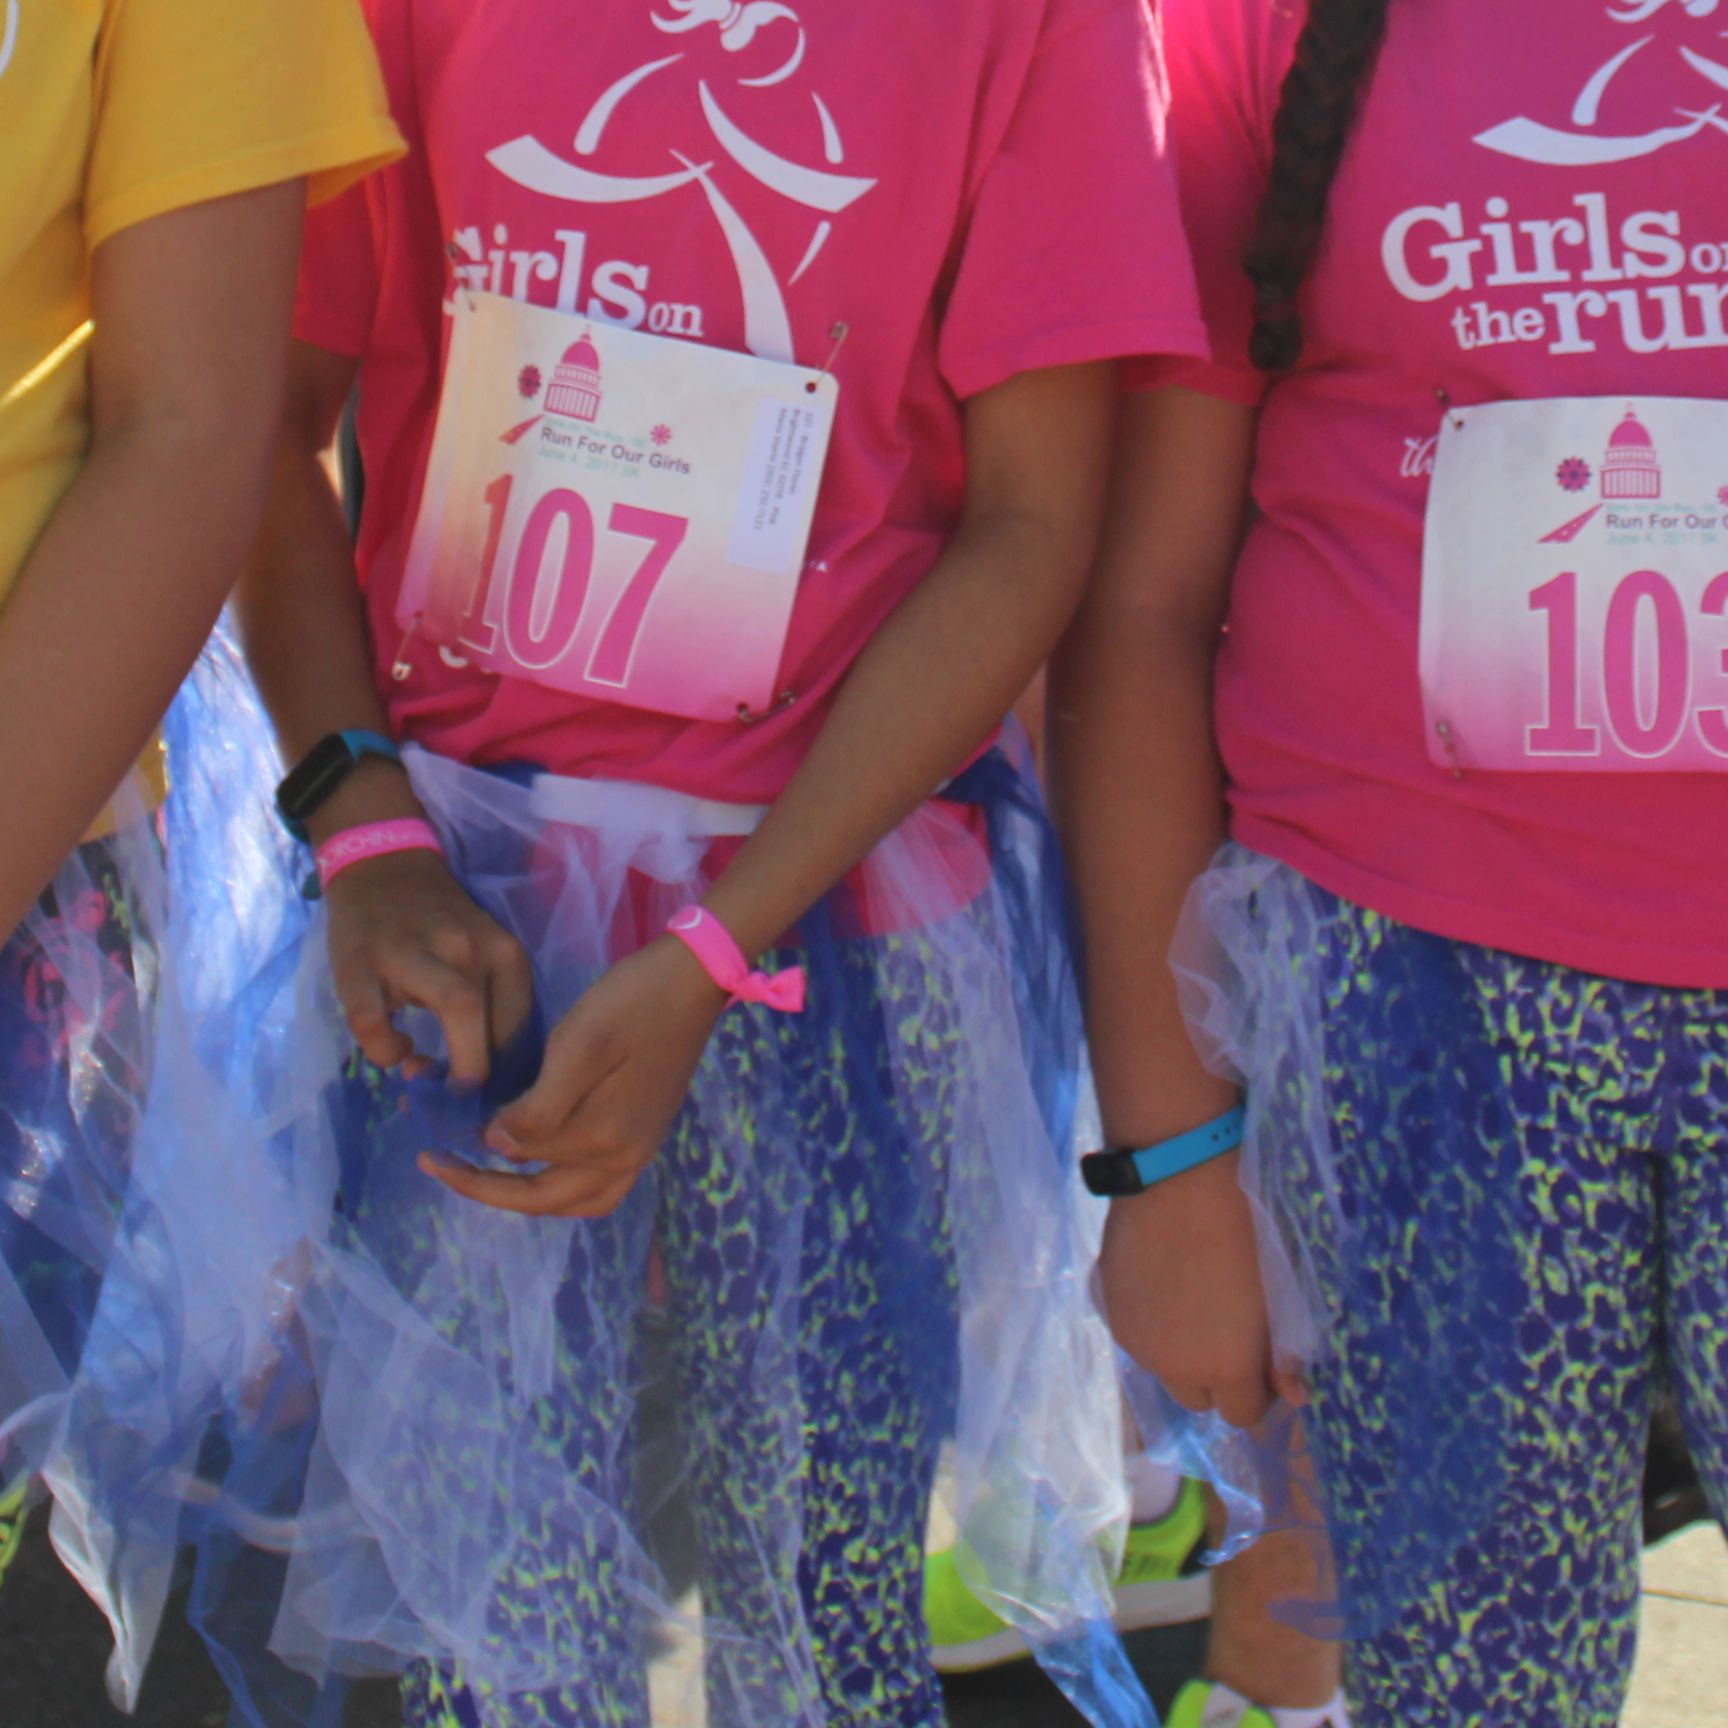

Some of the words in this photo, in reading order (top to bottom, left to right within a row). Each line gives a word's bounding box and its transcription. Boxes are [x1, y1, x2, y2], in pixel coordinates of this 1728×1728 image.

[1381, 192, 1686, 302] Girls
[647, 301, 704, 337] on
[1451, 302, 1545, 351] the
[539, 426, 573, 447] Run
[577, 435, 608, 454] For
[611, 444, 644, 464] Our
[649, 452, 691, 475] Girls
[1606, 513, 1643, 530] Run
[1649, 513, 1679, 529] For
[1685, 513, 1717, 529] Our
[458, 471, 688, 689] 107
